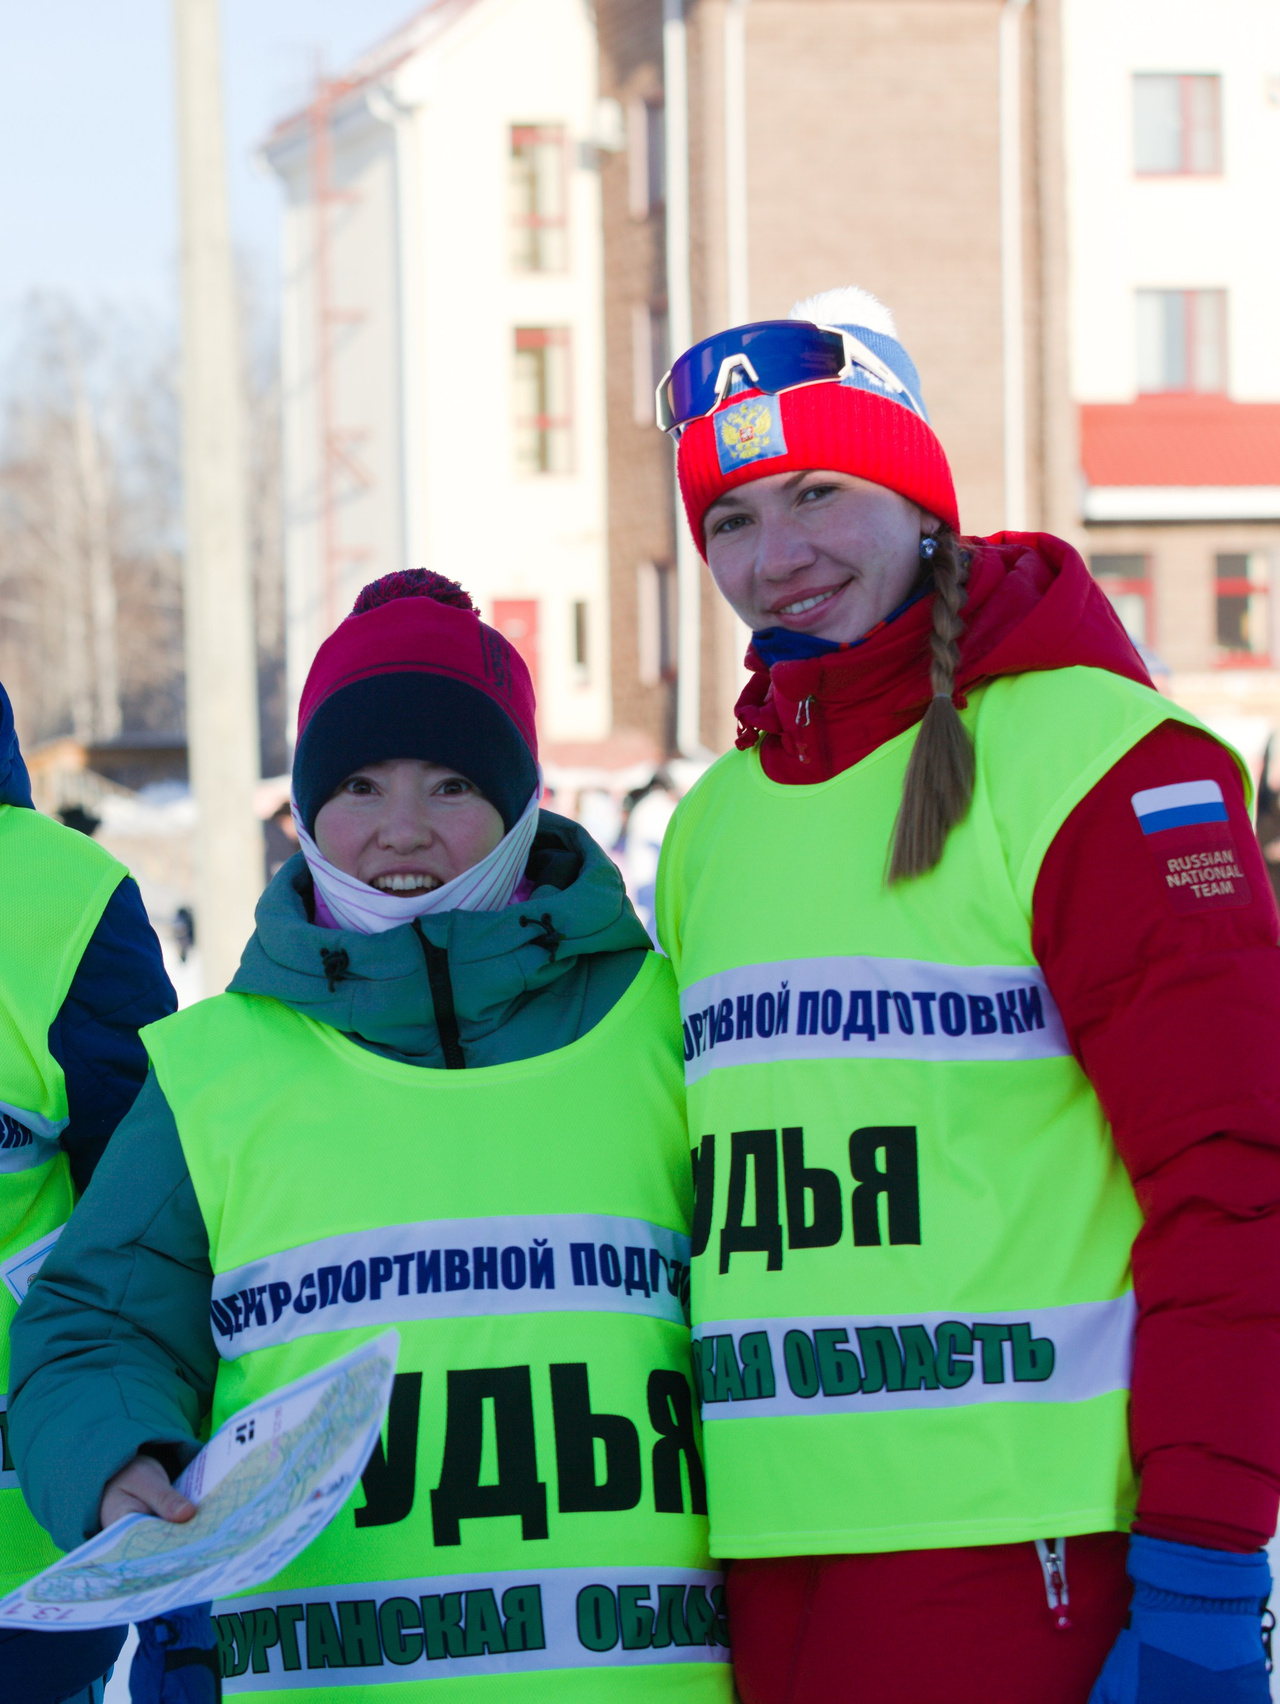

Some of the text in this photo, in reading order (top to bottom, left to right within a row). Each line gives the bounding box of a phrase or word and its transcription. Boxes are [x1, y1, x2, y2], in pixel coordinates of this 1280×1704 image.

[1165, 865, 1245, 888] NATIONAL
[1167, 850, 1235, 873] RUSSIAN
[1190, 881, 1235, 898] TEAM
[796, 985, 1046, 1042] ПОДГОТОВКИ
[211, 1281, 292, 1341] ЦЕНТР
[293, 1238, 556, 1314] СПОРТИВНОЙ
[783, 1321, 1055, 1399] ОБЛАСТЬ
[211, 1584, 547, 1678] КУРГАНСКАЯ
